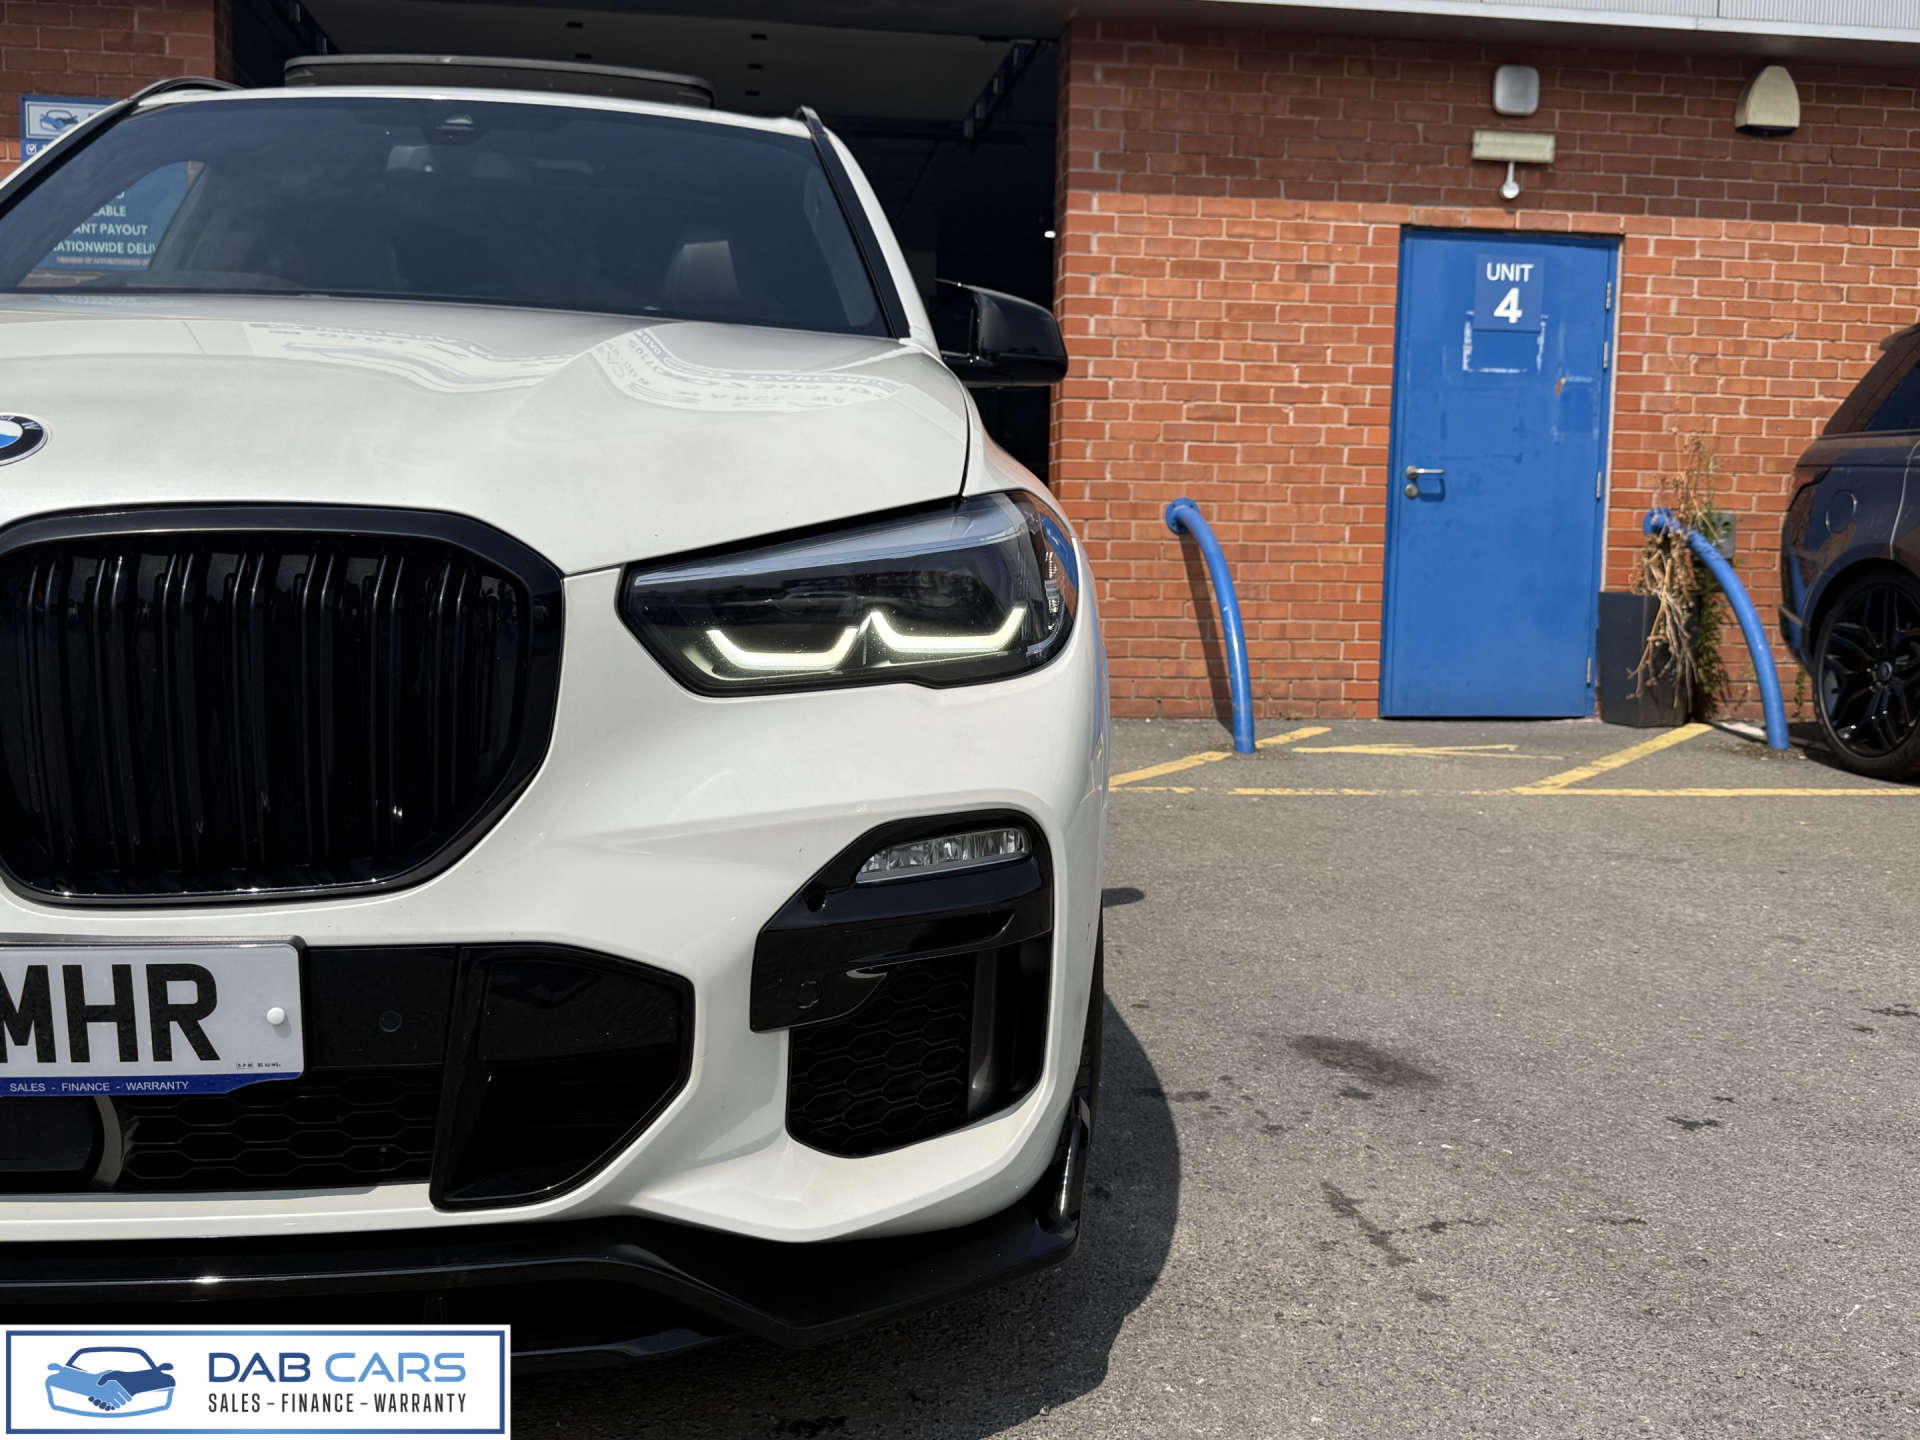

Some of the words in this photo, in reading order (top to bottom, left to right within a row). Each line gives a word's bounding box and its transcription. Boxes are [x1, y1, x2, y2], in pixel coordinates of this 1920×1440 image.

[92, 204, 127, 217] ABLE
[72, 222, 98, 235] ANT
[99, 222, 149, 237] PAYOUT
[127, 242, 159, 256] DELIV
[1486, 261, 1534, 282] UNIT
[1493, 287, 1523, 324] 4
[0, 963, 221, 1063] MHR
[9, 1082, 46, 1092] SALES
[61, 1082, 111, 1092] FINANCE
[126, 1081, 190, 1091] WARRANTY
